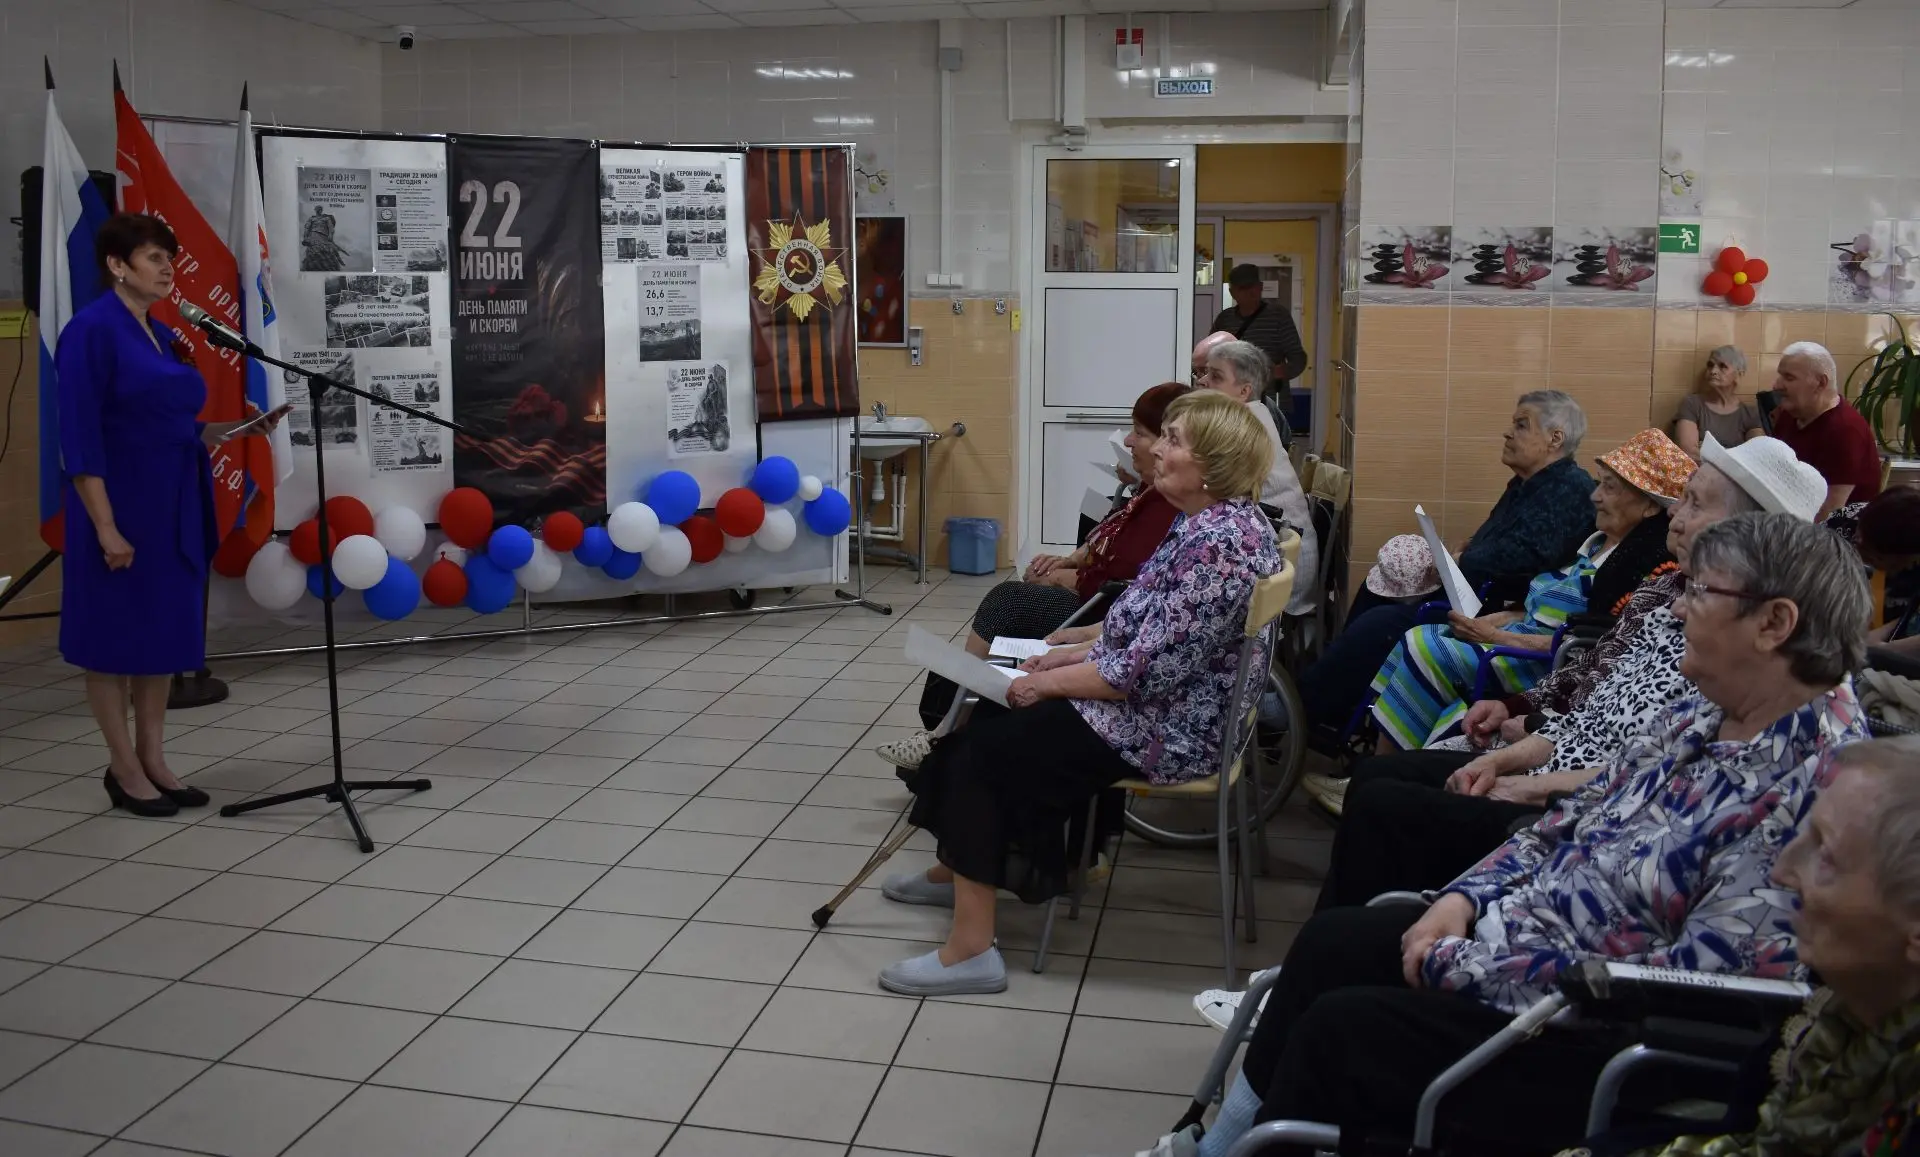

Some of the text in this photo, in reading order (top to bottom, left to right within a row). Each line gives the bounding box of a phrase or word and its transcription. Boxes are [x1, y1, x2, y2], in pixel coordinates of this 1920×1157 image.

[1160, 81, 1209, 94] ВЫХОД
[328, 173, 356, 181] ИЮНЯ
[459, 180, 522, 248] 22
[460, 252, 524, 280] ИЮНЯ
[778, 242, 818, 288] ОТЕЧЕСТВЕННАЯ
[646, 289, 665, 299] 26,6
[458, 299, 528, 316] ДЕНЬ ПАМЯТИ
[646, 306, 664, 317] 13,7
[470, 318, 518, 333] И СКОРБИ
[318, 350, 330, 358] 1941
[680, 368, 706, 376] 22 ИЮНЯ
